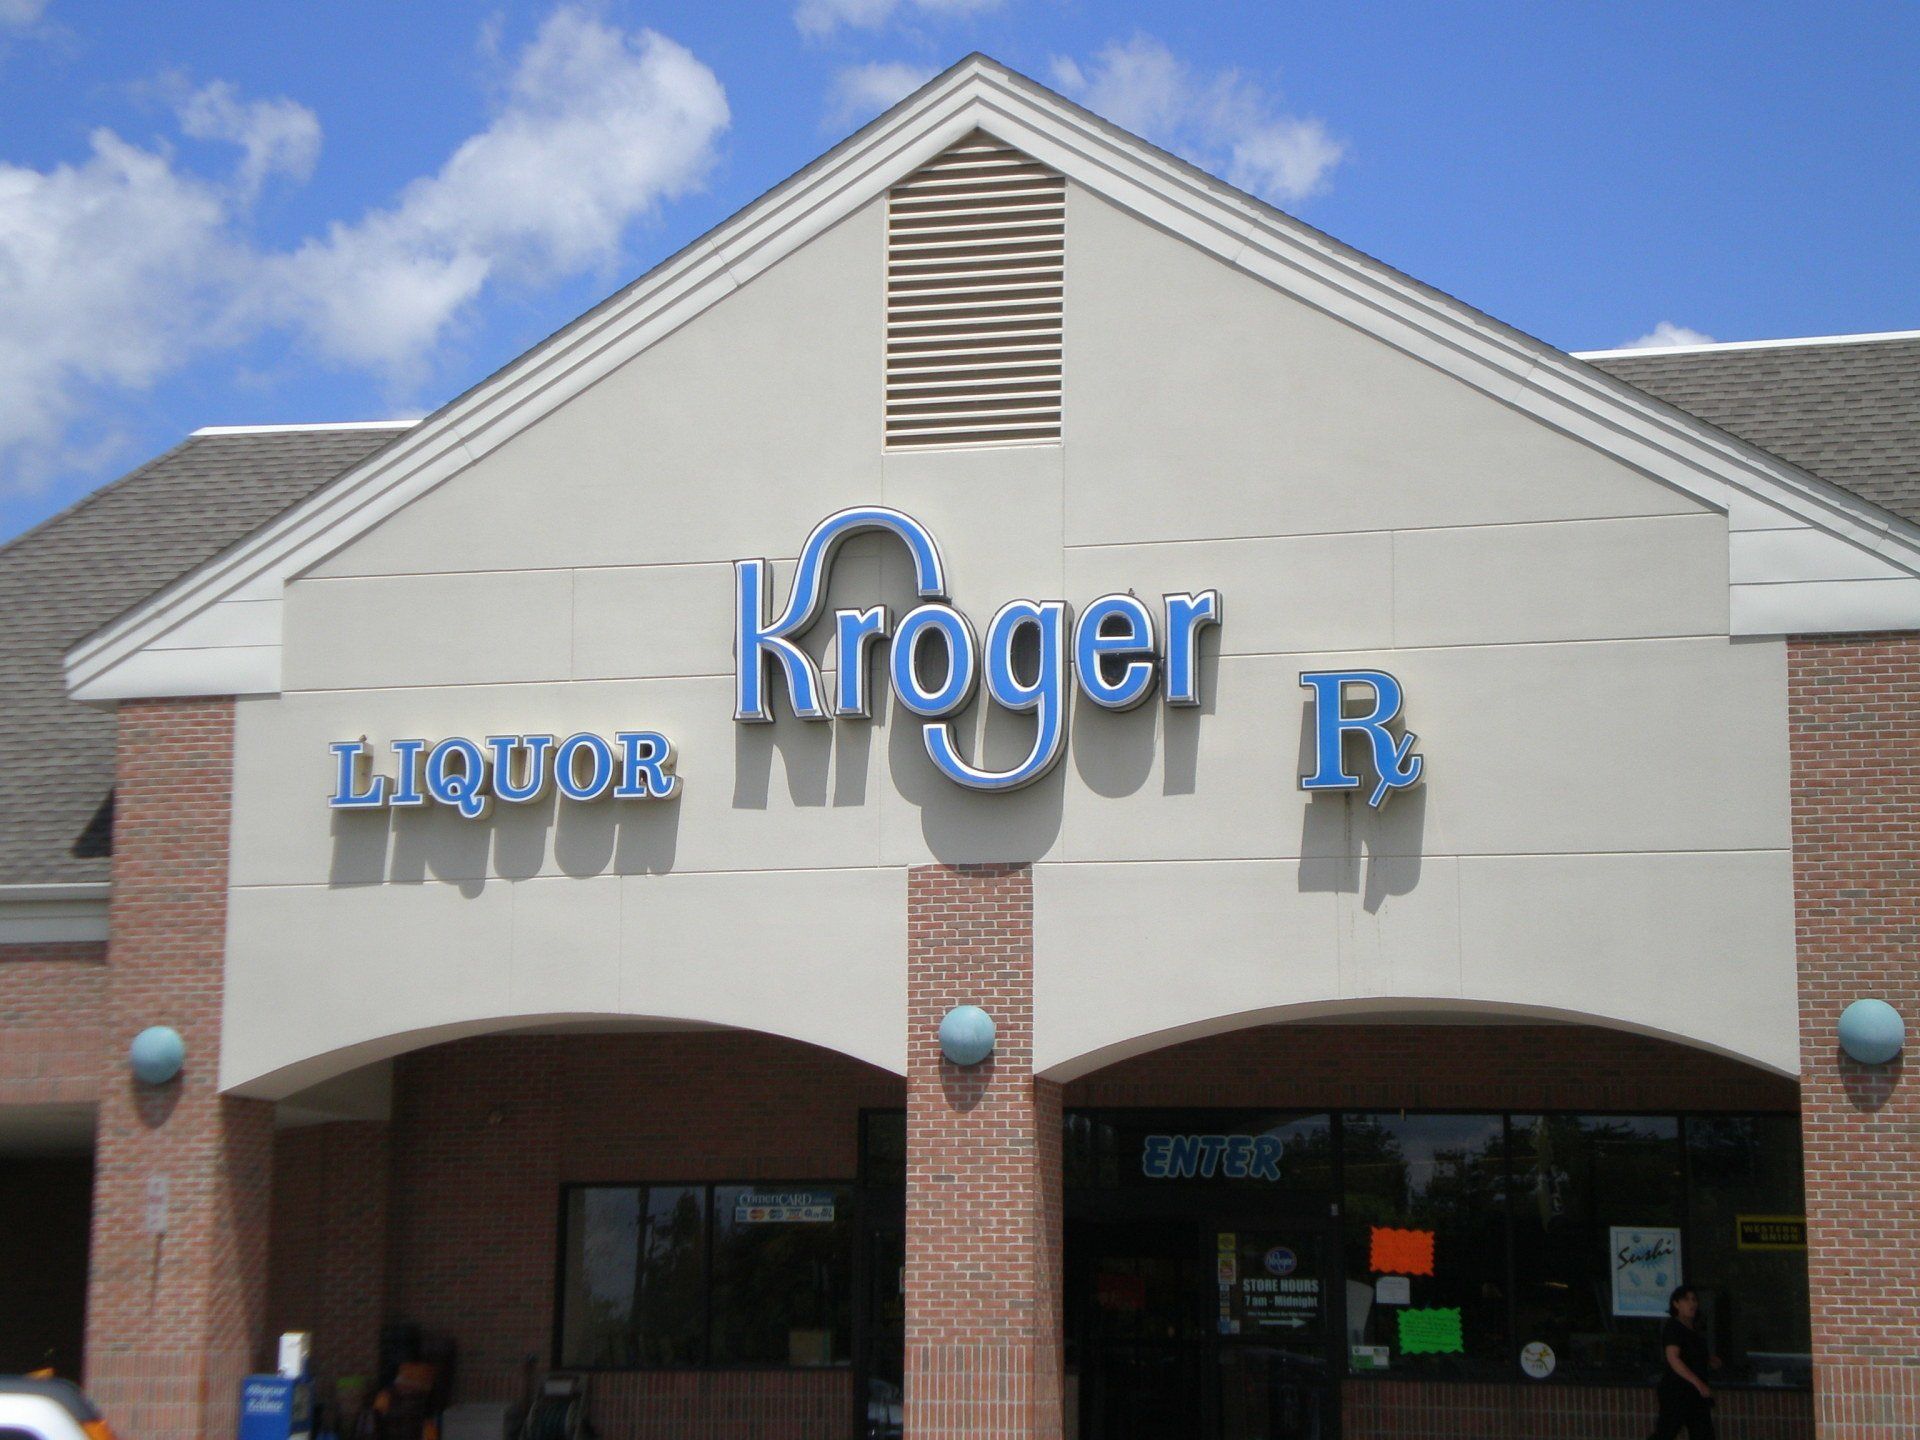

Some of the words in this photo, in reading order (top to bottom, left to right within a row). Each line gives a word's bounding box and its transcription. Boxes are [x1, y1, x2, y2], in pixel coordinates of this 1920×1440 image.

[733, 505, 1223, 793] Kroger
[328, 731, 684, 820] LIQUOR
[1142, 1135, 1283, 1181] ENTER
[1617, 1238, 1673, 1270] Sushi
[1242, 1278, 1279, 1292] STORE
[1280, 1279, 1319, 1293] HOURS
[1274, 1295, 1318, 1308] Midnight
